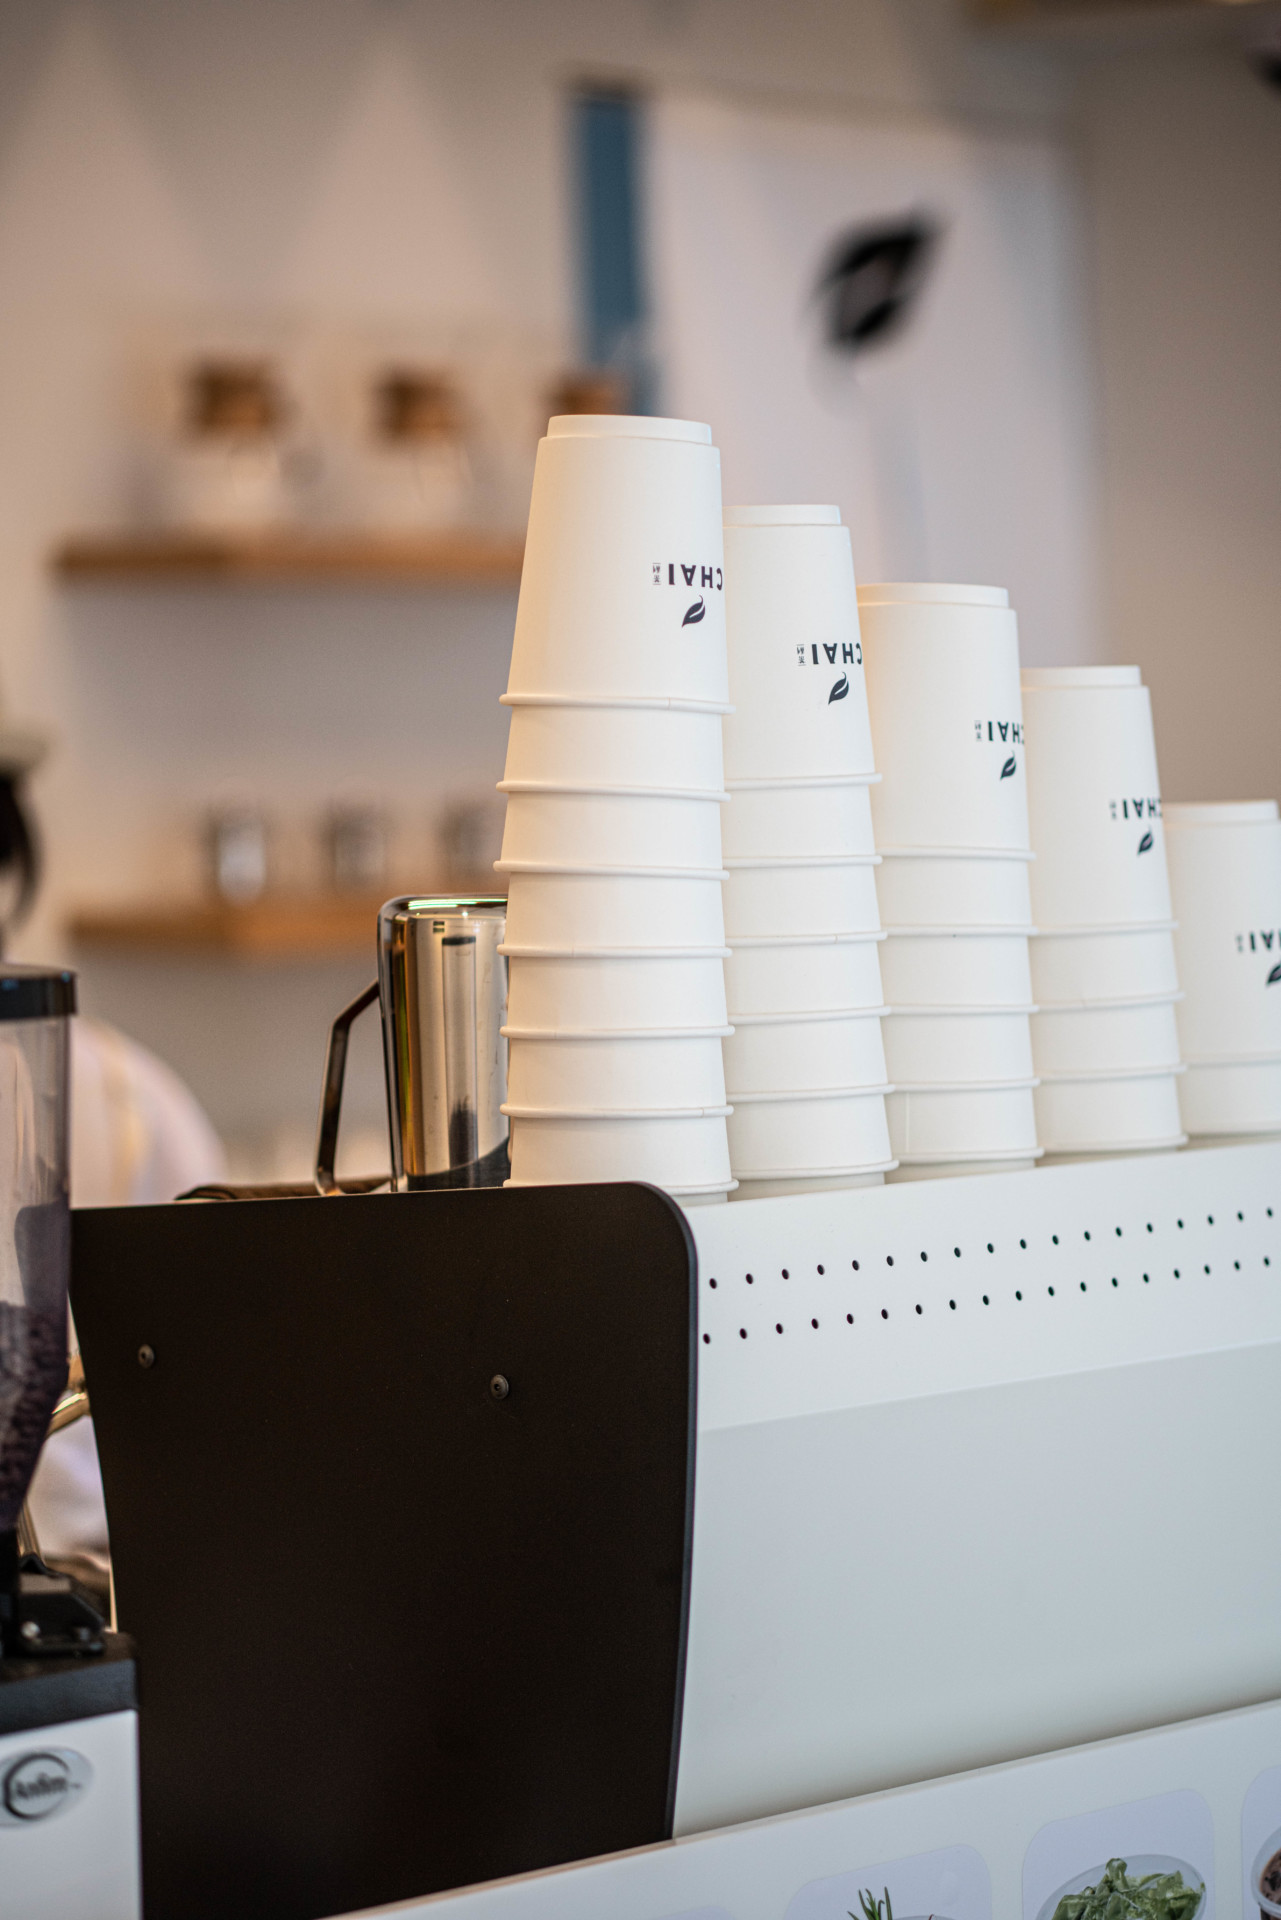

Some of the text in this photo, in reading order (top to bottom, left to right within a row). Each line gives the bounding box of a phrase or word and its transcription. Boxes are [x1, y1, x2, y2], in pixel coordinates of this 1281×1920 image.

[668, 563, 723, 591] CHAI
[811, 642, 863, 665] CHAI
[1122, 797, 1162, 819] HAI
